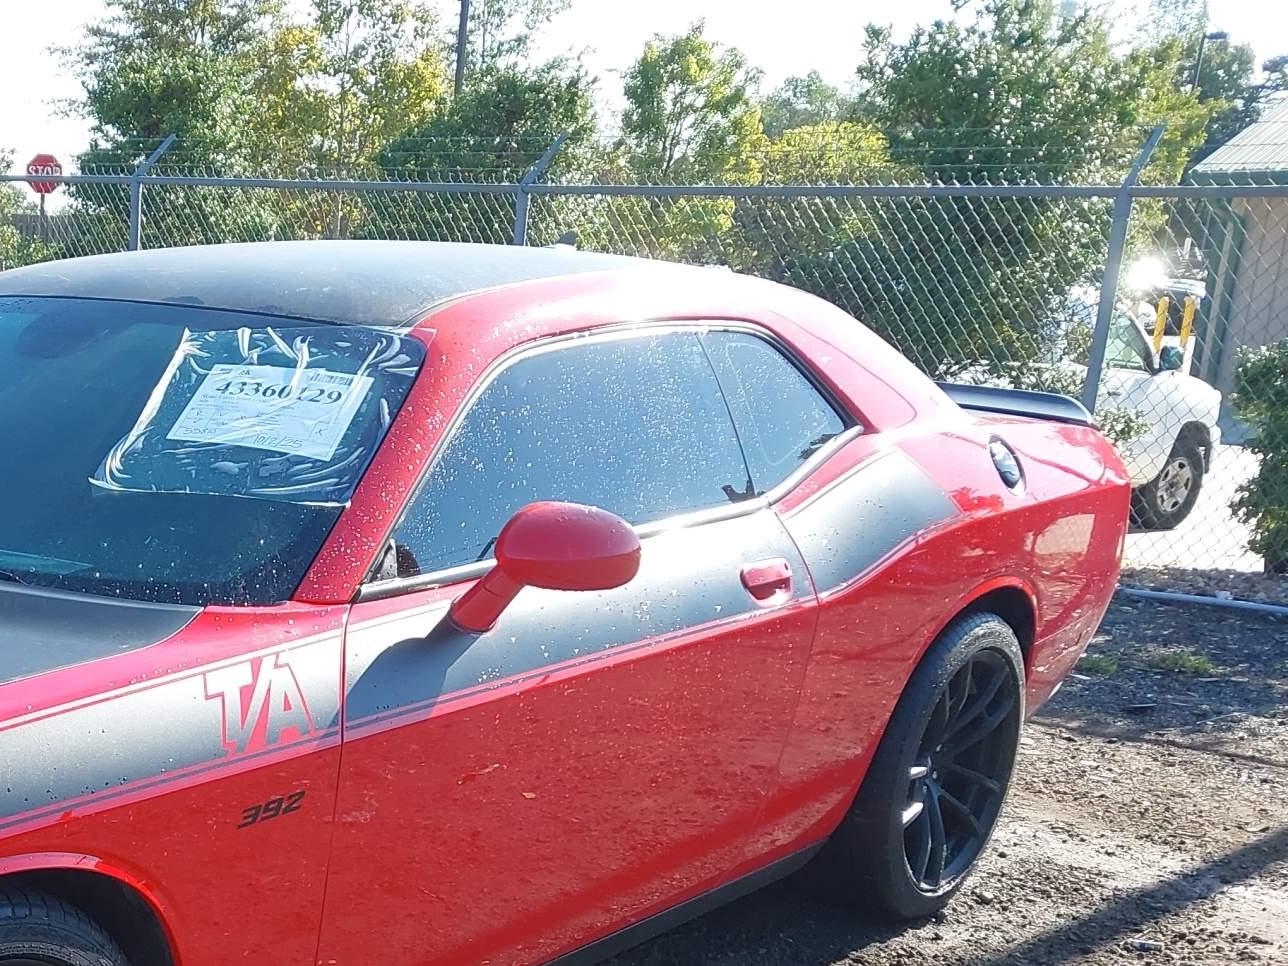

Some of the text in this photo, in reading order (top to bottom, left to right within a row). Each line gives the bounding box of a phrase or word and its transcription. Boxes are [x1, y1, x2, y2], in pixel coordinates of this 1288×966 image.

[28, 164, 60, 177] STOP
[215, 380, 343, 405] 43360129
[237, 790, 306, 829] 392
